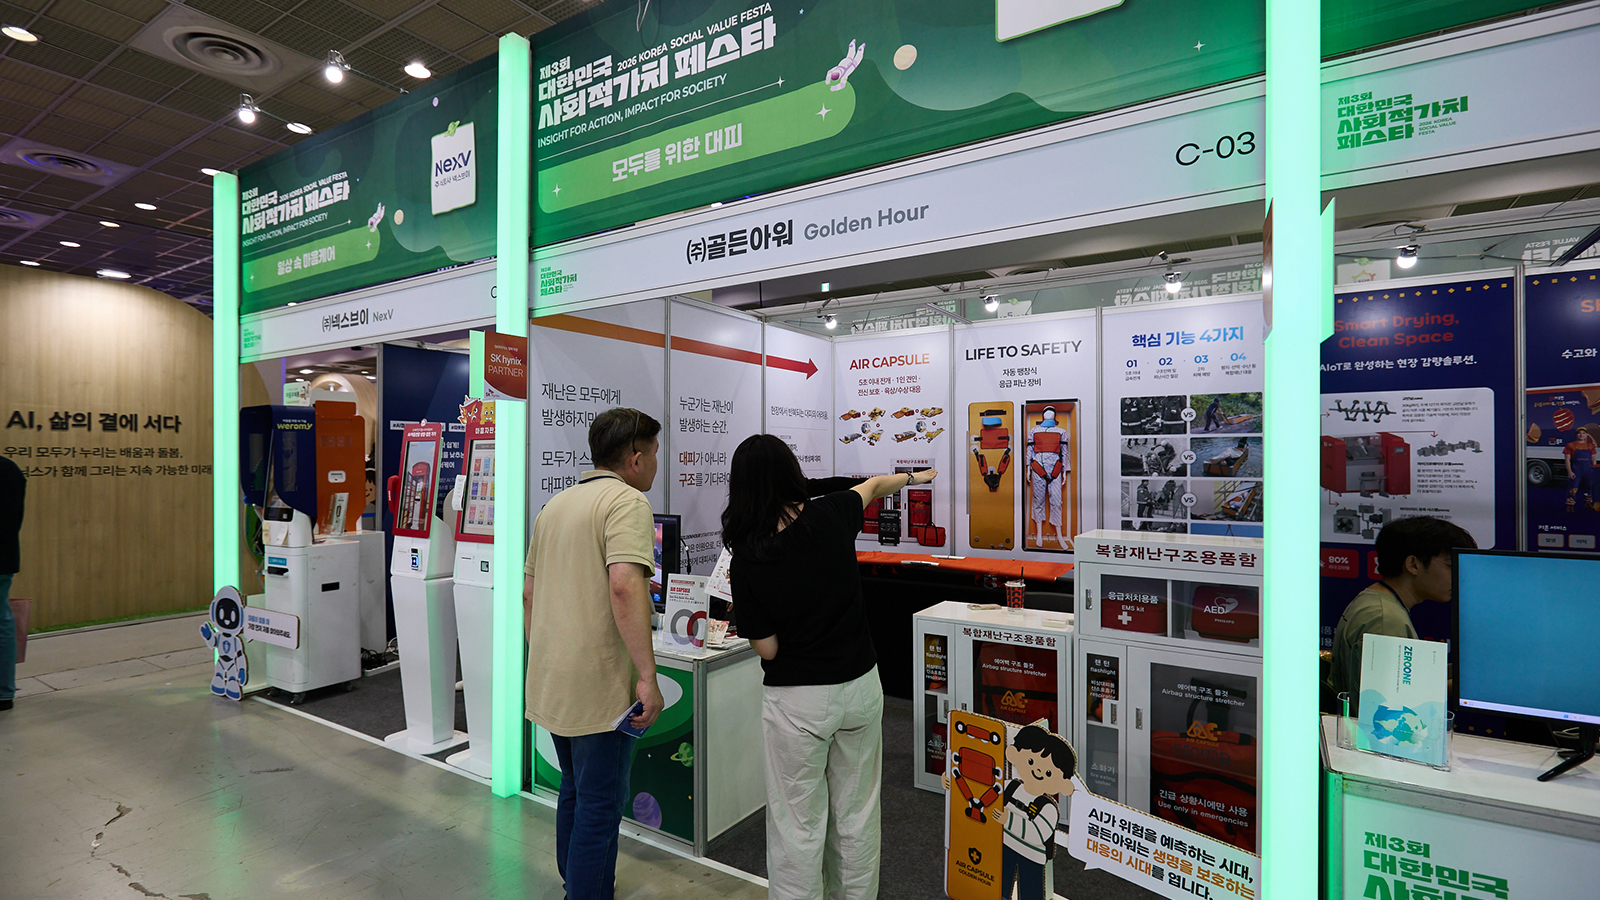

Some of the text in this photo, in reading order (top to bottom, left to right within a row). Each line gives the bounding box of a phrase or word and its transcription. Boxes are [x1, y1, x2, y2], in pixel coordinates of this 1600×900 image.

[617, 2, 772, 72] 2026 KOREA SOCIAL VALUE FESTA
[538, 15, 776, 130] 사회적가치 페스타
[539, 55, 571, 80] 제3회
[538, 54, 612, 101] 대한민국
[1337, 91, 1373, 105] 제3회
[1337, 93, 1413, 118] 대한민국
[538, 73, 727, 148] INSIGHT FOR ACTION, IMPACT FOR SOCIETY
[1337, 95, 1469, 134] 사회적가치
[1418, 121, 1457, 132] SOCIAL VALUE
[1433, 117, 1453, 125] KOREA
[1337, 124, 1415, 150] 페스타
[612, 123, 742, 182] 모두를 위한 대피
[1175, 131, 1256, 166] C-03
[435, 150, 471, 177] NexV
[242, 180, 350, 235] 사회적가치 페스타
[804, 217, 871, 241] Golden
[877, 203, 929, 227] Hour
[277, 245, 336, 276] 일상 속 마음케어
[373, 309, 394, 323] NexV
[1392, 312, 1460, 328] Drying,
[1132, 326, 1244, 348] 핵심 기능 4가지
[1338, 331, 1454, 349] Clean Space
[490, 353, 522, 366] SK hynix
[966, 340, 1082, 361] LIFE TO SAFETY
[1561, 348, 1598, 359] 수고와
[849, 353, 930, 370] AIR CAPSULE
[1126, 352, 1247, 368] 01 02 03 04
[1354, 359, 1395, 372] 완성하는
[1397, 358, 1418, 369] 현장
[488, 365, 524, 377] PARTNER
[1002, 367, 1037, 377] 자동 팽창식
[868, 377, 879, 385] 이내
[999, 378, 1042, 388] 응급 피난 장비
[542, 382, 621, 405] 재난은 모두에게
[679, 397, 734, 414] 누군가는 재난이
[6, 410, 182, 433] AI, 삶의 곁에 서다
[277, 422, 313, 430] weromy
[679, 418, 729, 435] 발생하는 순간,
[4, 446, 154, 458] 우리 모두가 누리는 배움과
[542, 450, 577, 467] 모두가
[679, 451, 727, 465] 대피가 아니라
[61, 464, 212, 477] 함께 그리는 지속 가능한 미래
[679, 472, 703, 487] 구조를
[1095, 543, 1257, 568] 복합재난구조용품함
[1328, 556, 1349, 564] 80%
[1108, 591, 1159, 605] 응급처치용품
[1121, 604, 1135, 612] EMS
[1203, 605, 1225, 615] AED
[962, 627, 1056, 647] 복합재난구조용품함
[982, 663, 1047, 678] Airbag structure stretcher
[994, 658, 1010, 666] 에어백
[1402, 645, 1413, 686] ZEROONE
[1090, 667, 1116, 676] flashlight
[1161, 688, 1245, 707] Airbag structure stretcher
[1177, 682, 1229, 698] 에어백 구조 들것
[1091, 762, 1115, 774] 소화기
[1159, 788, 1248, 817] 긴급 상황시에만 사용
[1157, 800, 1249, 827] Use only in emergencies
[1088, 807, 1254, 884] AI가 위험을 예측하는 시대,
[1364, 831, 1430, 858] 제3회
[1087, 838, 1123, 865] 대응의
[1125, 856, 1165, 881] 시대를
[1087, 823, 1255, 900] 골든아워는 생명을 보호하는
[956, 859, 995, 883] AIR CAPSULE
[958, 868, 992, 887] GOLDEN HOUR
[1363, 849, 1510, 900] 대한민국
